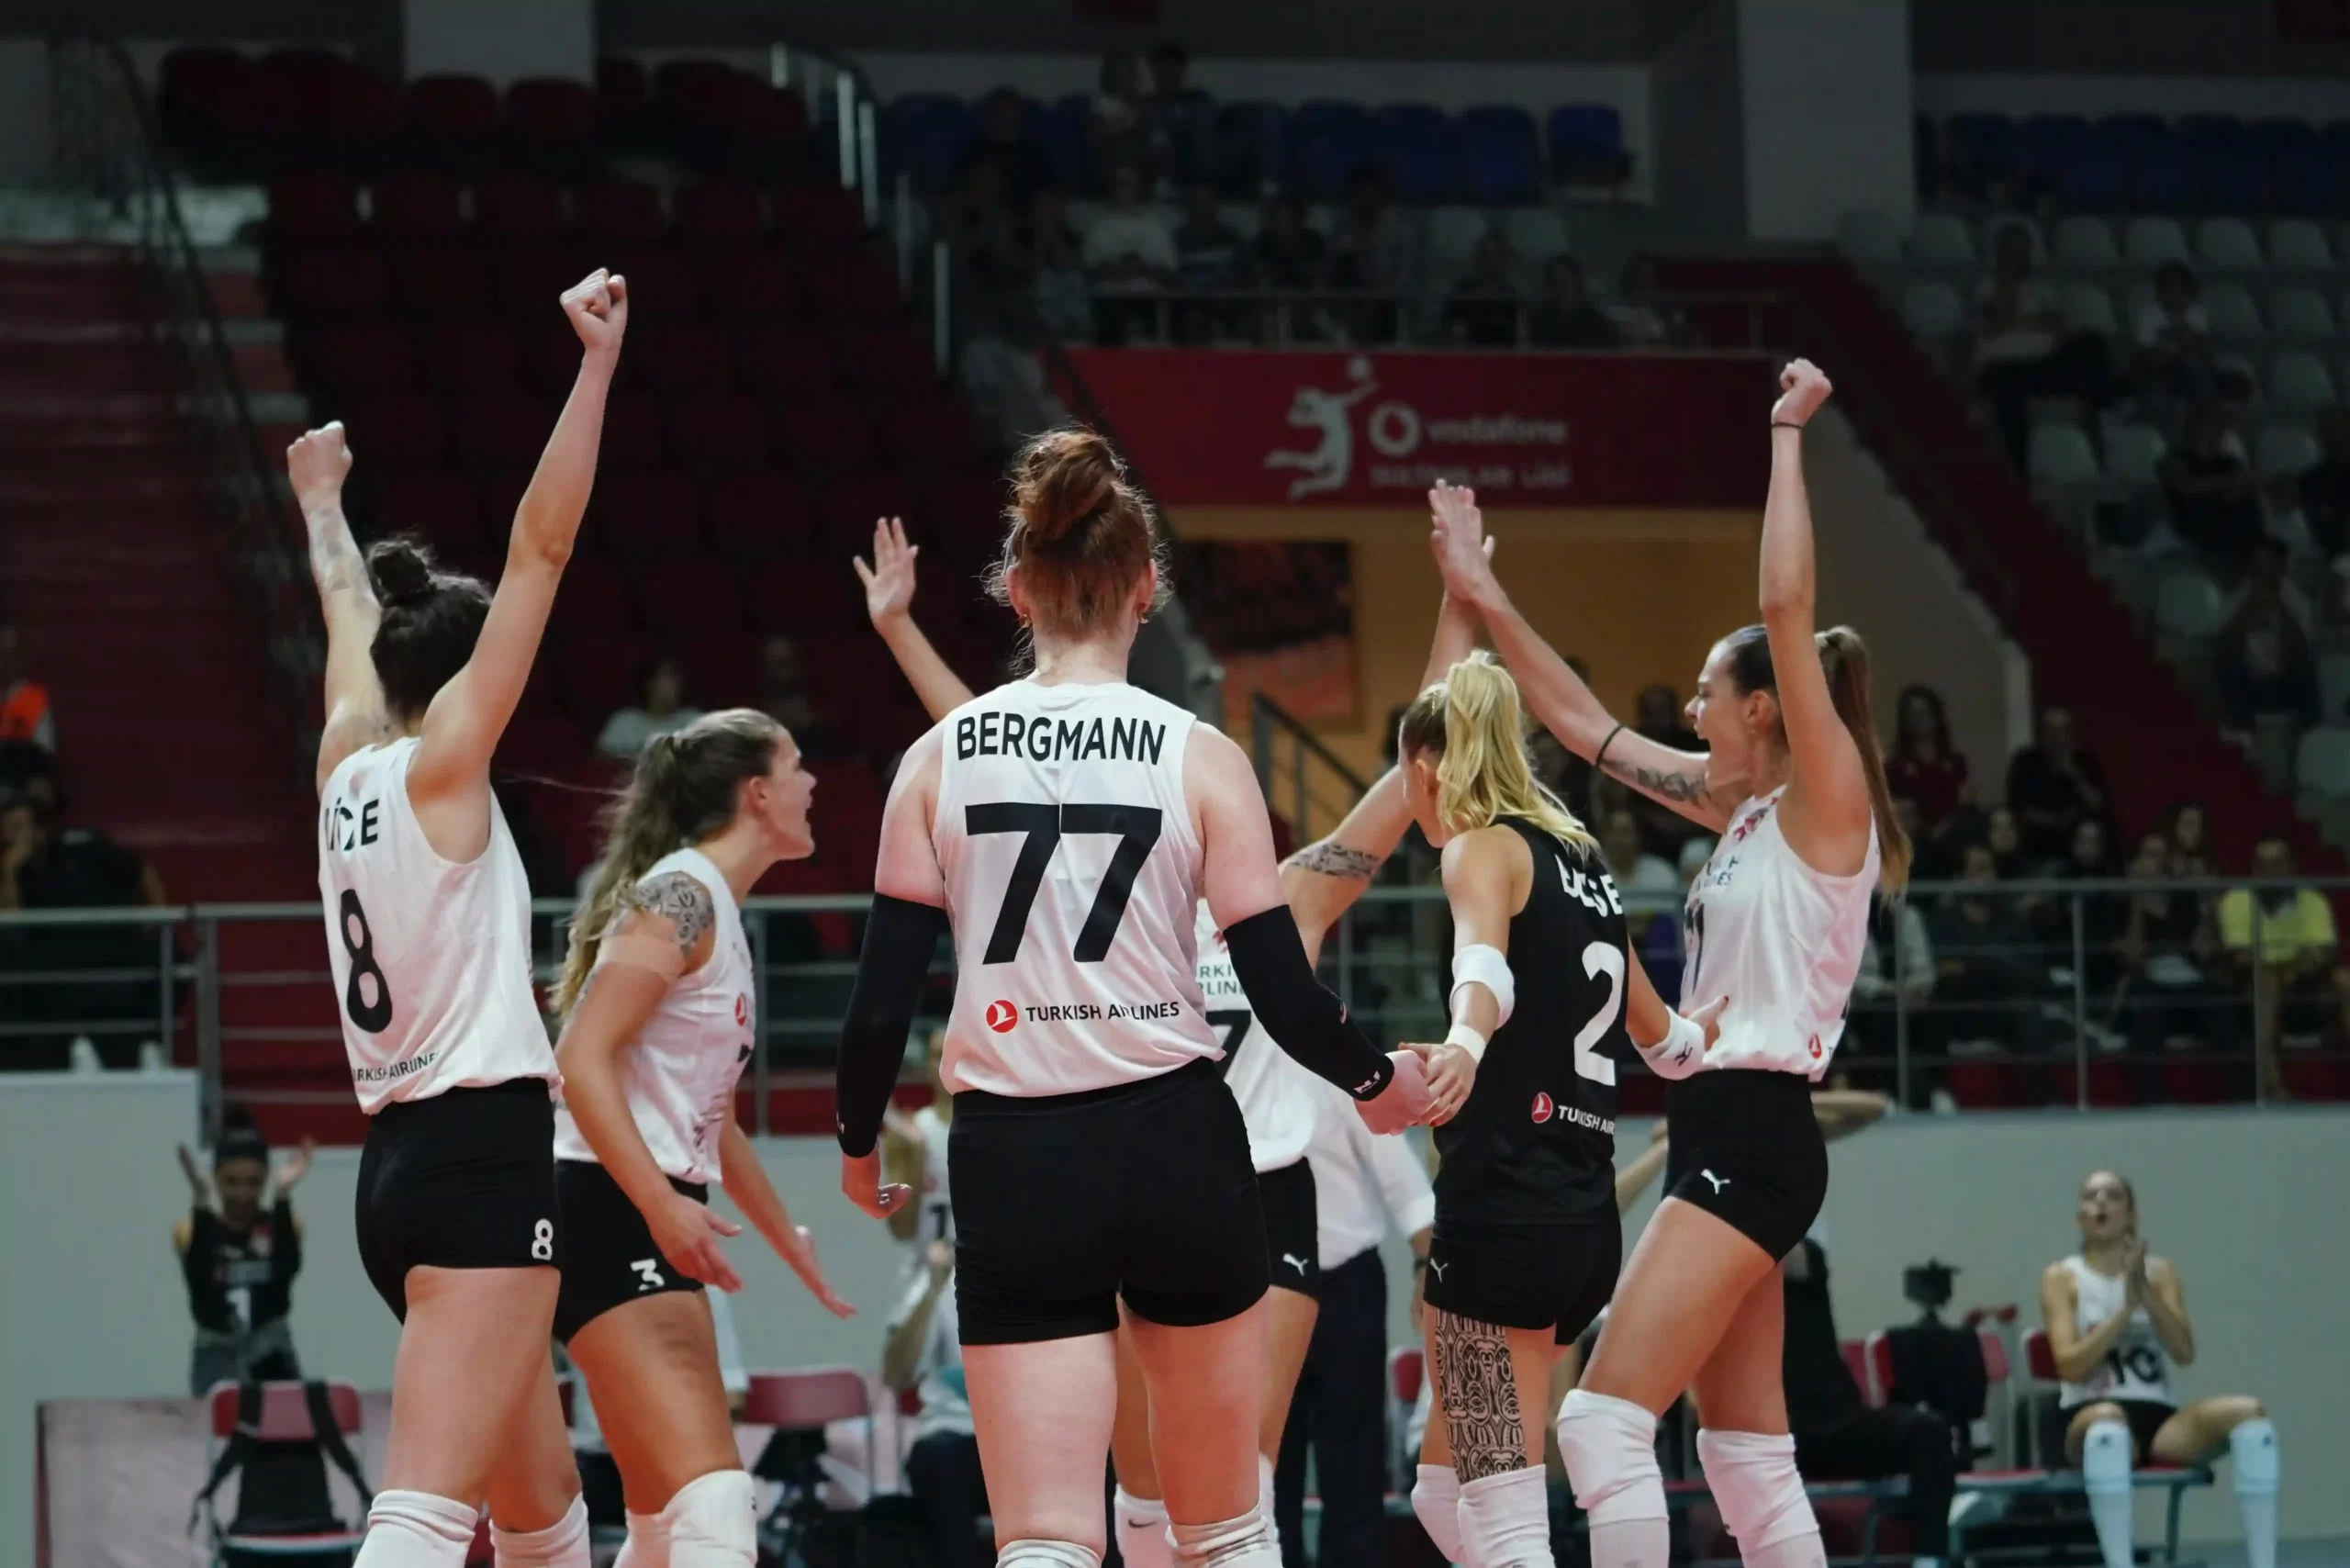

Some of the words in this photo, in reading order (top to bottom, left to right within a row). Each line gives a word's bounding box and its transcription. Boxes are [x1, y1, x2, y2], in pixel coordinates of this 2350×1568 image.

[1427, 413, 1567, 443] vodafone
[957, 711, 1166, 765] BERGMANN
[965, 801, 1163, 965] 77
[340, 888, 393, 1034] 8
[1025, 1004, 1102, 1022] TURKISH
[1107, 1002, 1180, 1021] AIRLINES
[1573, 940, 1625, 1085] 2
[531, 1217, 554, 1260] 8
[630, 1258, 666, 1291] 3
